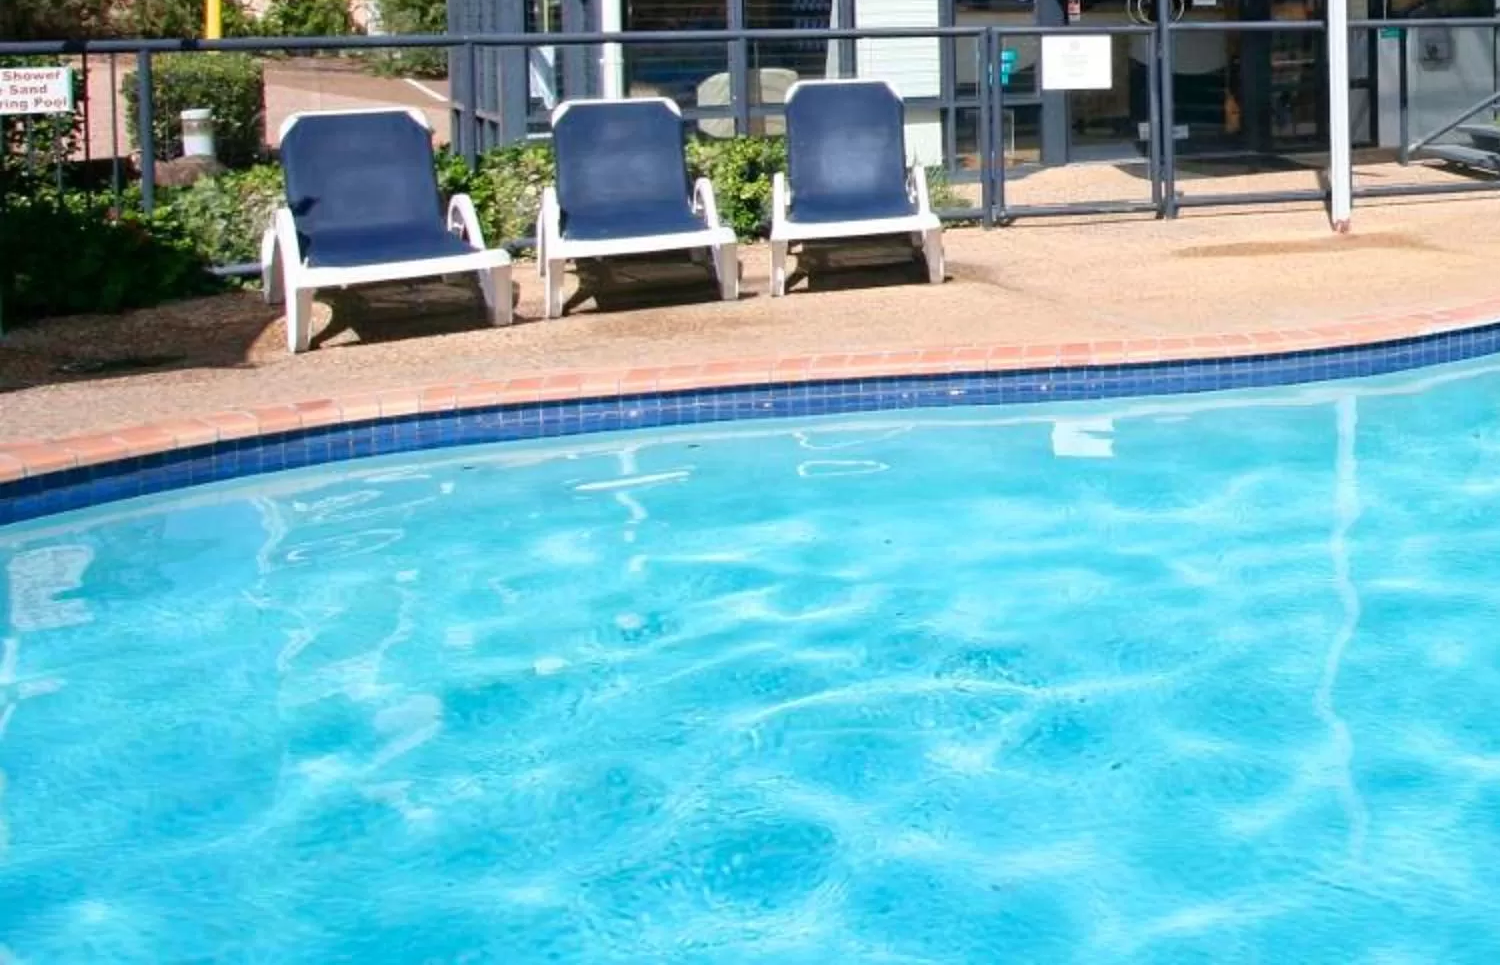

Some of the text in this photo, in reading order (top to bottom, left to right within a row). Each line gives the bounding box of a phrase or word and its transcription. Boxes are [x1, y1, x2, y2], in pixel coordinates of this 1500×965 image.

[2, 70, 61, 81] Shower
[9, 84, 48, 95] Sand
[33, 96, 67, 108] Pool
